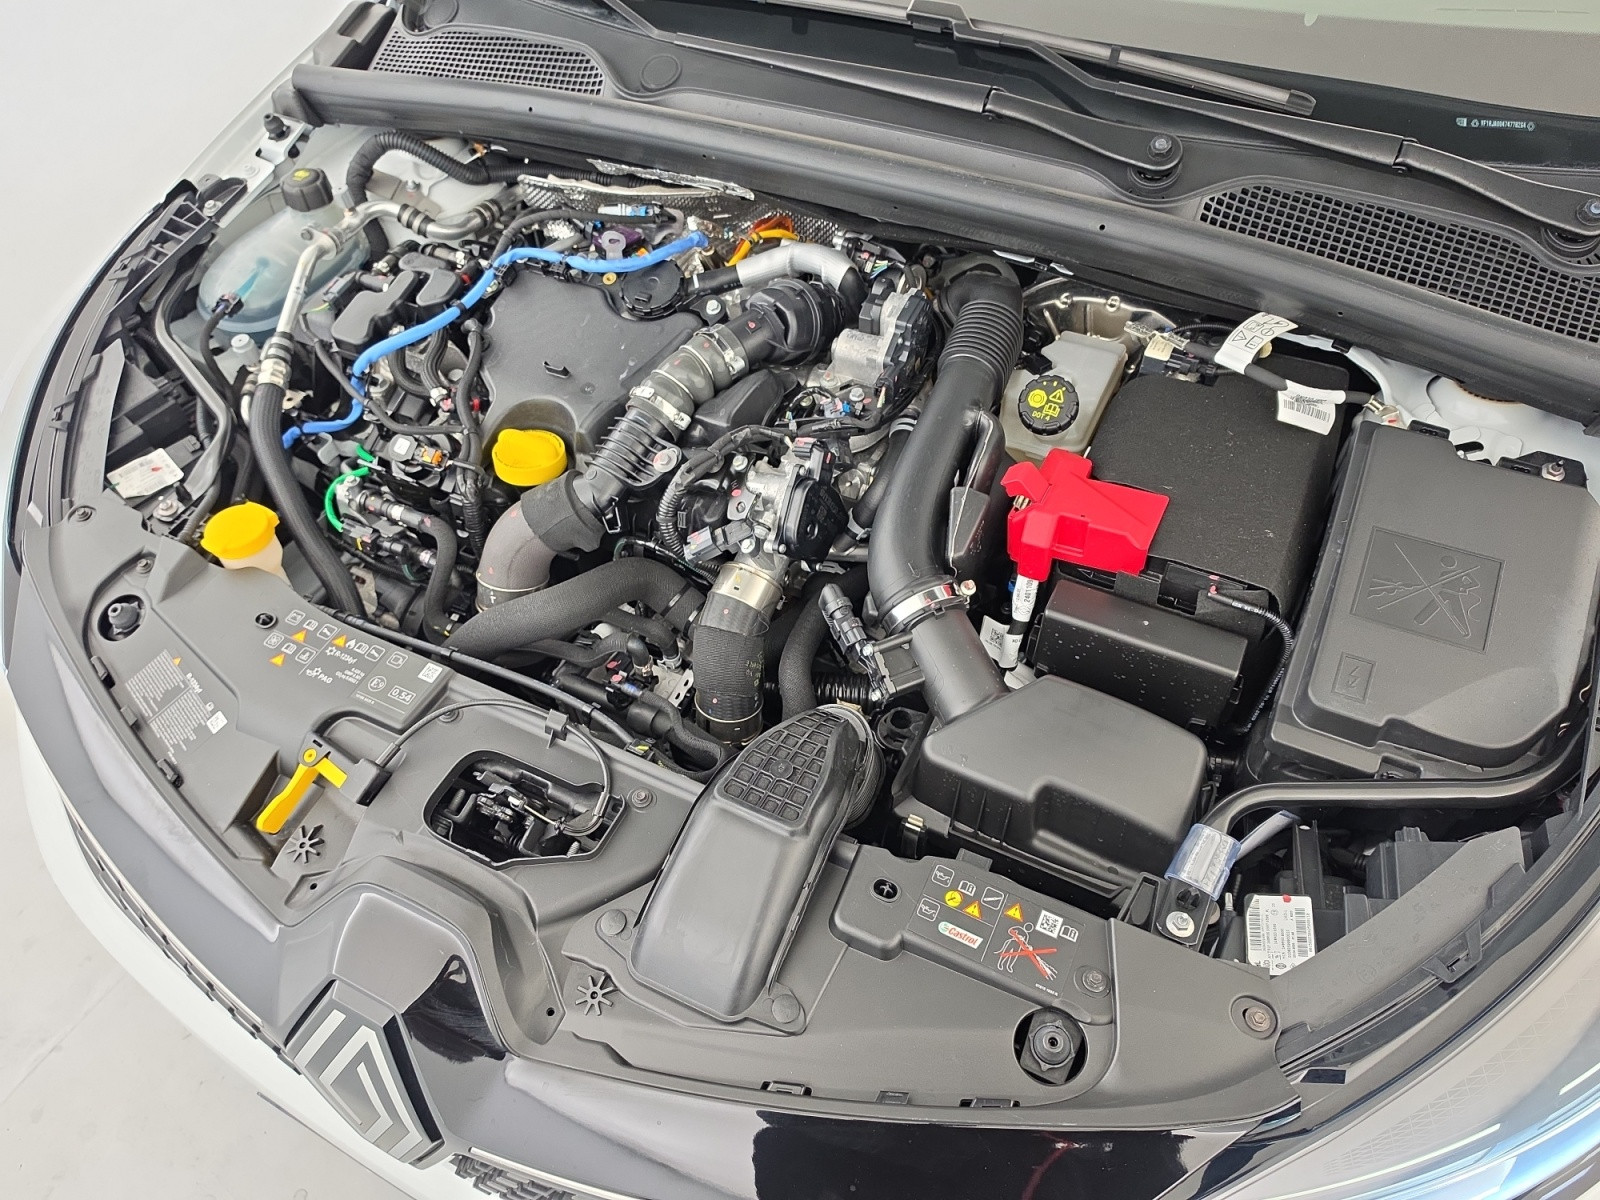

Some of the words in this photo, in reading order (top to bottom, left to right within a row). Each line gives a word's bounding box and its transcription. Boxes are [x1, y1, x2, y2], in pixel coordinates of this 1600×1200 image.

[1031, 410, 1046, 420] DOT
[334, 650, 358, 665] R-1234yf
[317, 673, 333, 684] PAG
[948, 927, 979, 946] Castrol
